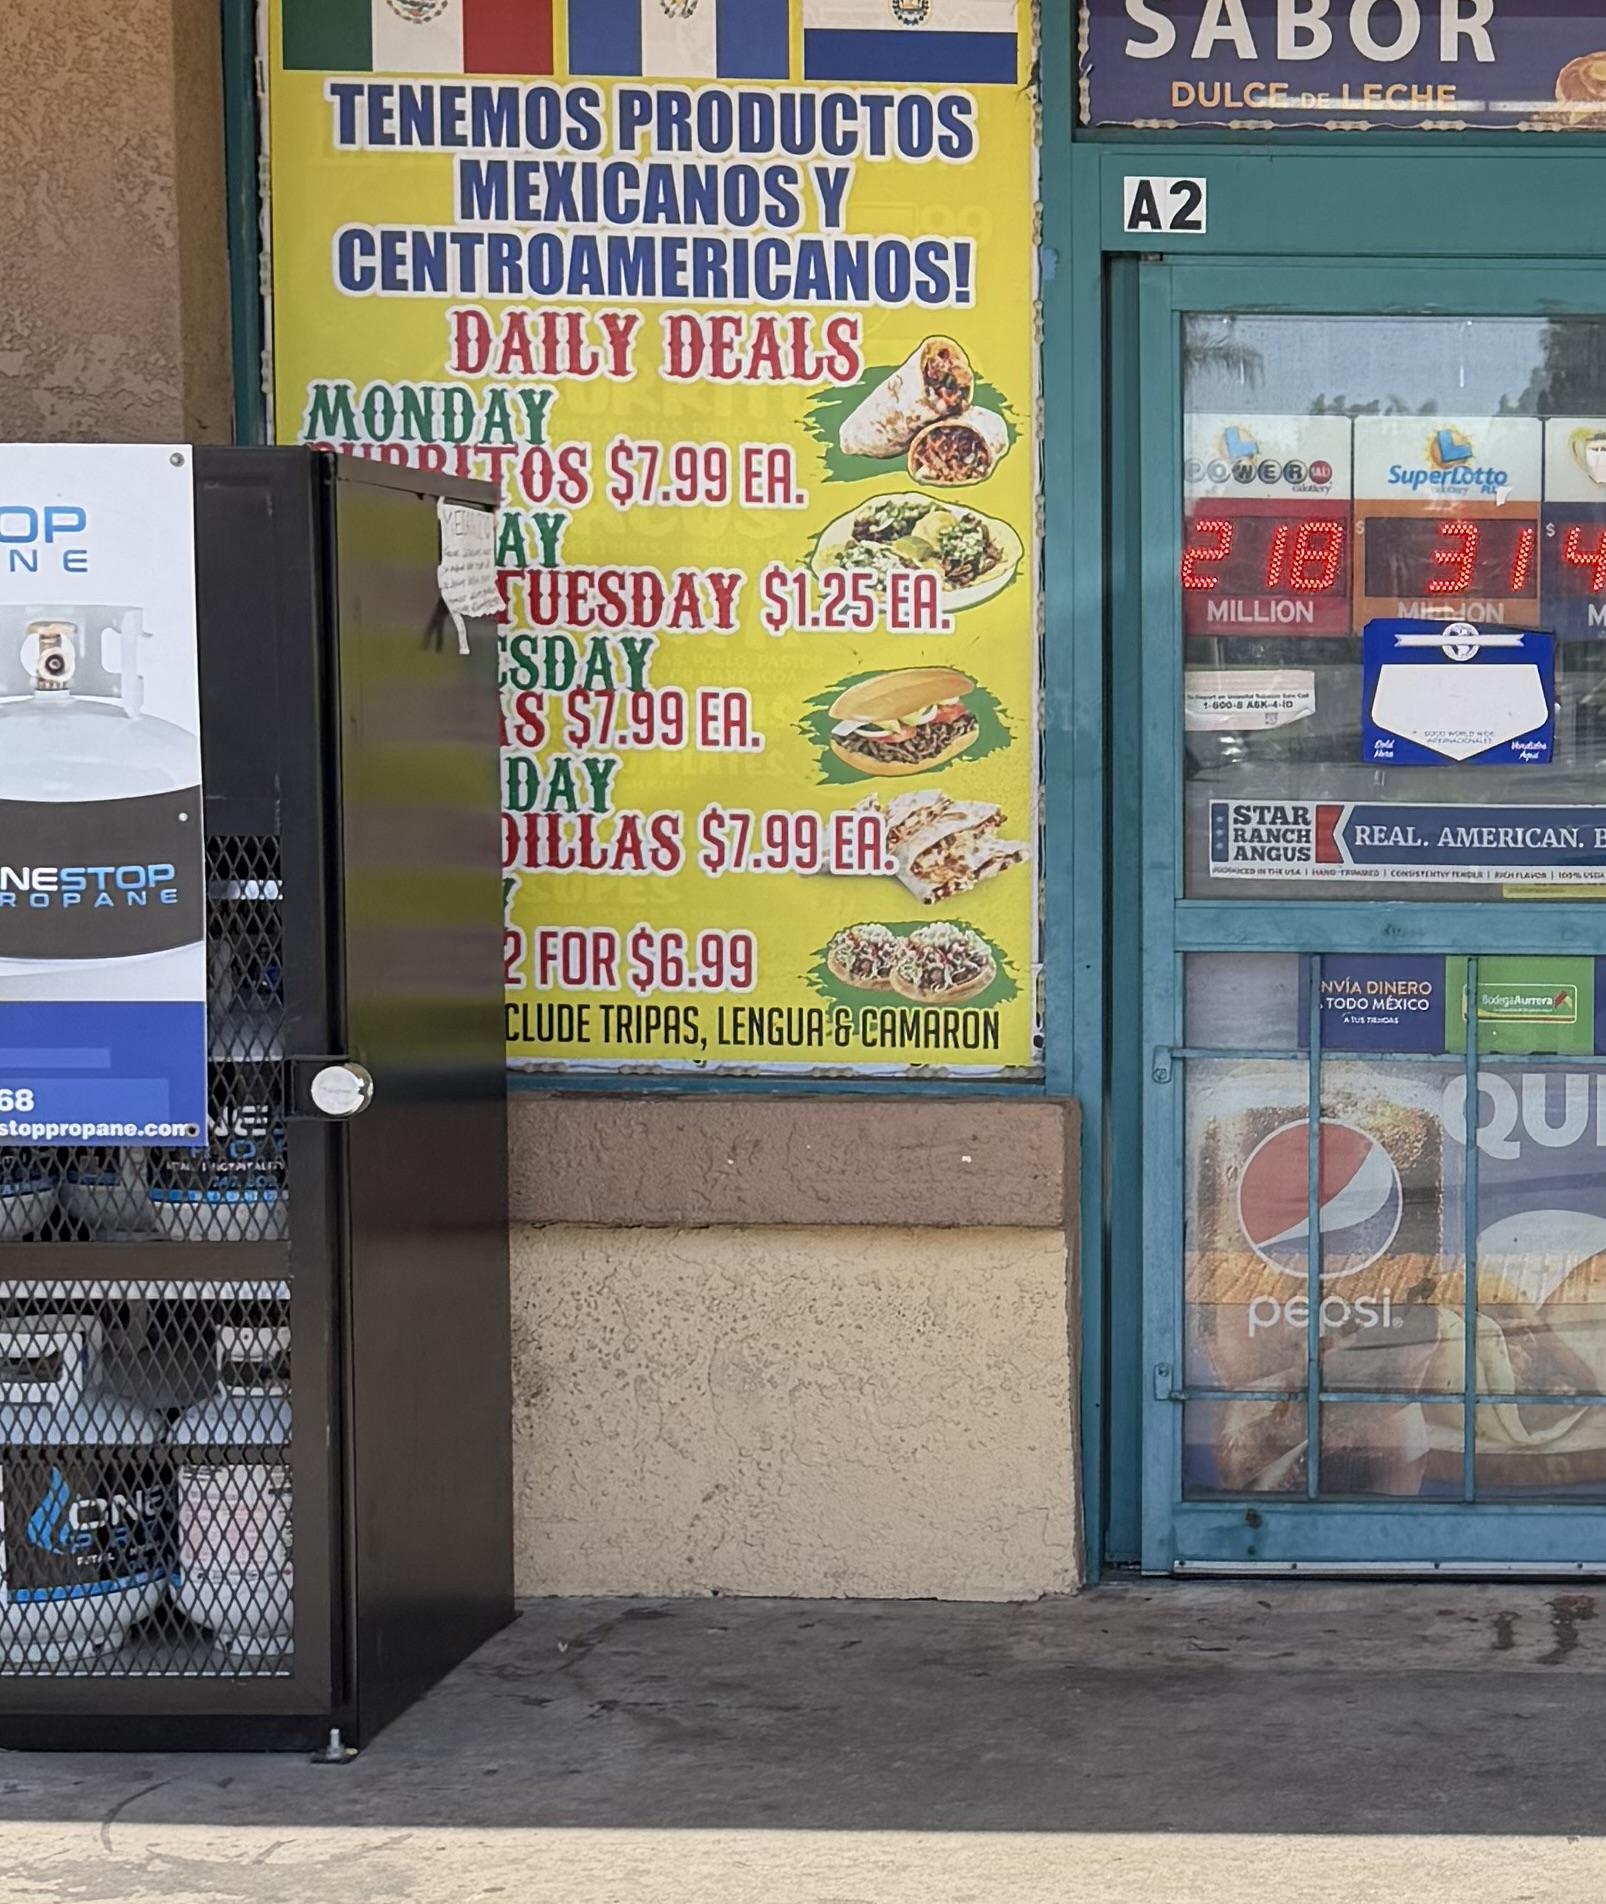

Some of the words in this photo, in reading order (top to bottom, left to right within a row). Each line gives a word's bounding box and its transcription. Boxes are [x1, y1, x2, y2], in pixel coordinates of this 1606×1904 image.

[331, 84, 604, 149] TENEMOS
[620, 89, 973, 156] PRODUCTOS
[1171, 81, 1288, 108] DULCE
[1302, 92, 1329, 108] DE
[1342, 83, 1457, 110] LECHE
[460, 160, 800, 227] MEXICANOS
[819, 166, 850, 228] Y
[1127, 179, 1202, 230] A2
[337, 229, 974, 303] CENTROAMERICANOS!
[449, 312, 640, 378] DAILY
[661, 315, 860, 382] DEALS
[305, 384, 553, 444] MONDAY
[611, 438, 725, 507] $7.99
[745, 447, 804, 503] EA.
[1388, 465, 1508, 490] SuperLotto
[496, 569, 742, 630] TUESDAY
[765, 566, 875, 633] $1.25
[888, 573, 951, 632] EA.
[1207, 601, 1314, 623] MILLION
[568, 685, 684, 749] $7.99
[701, 692, 760, 747] EA.
[703, 808, 818, 873] $7.99
[835, 815, 895, 872] EA.
[1233, 805, 1312, 826] STAR
[1233, 828, 1311, 844] RANCH
[1355, 825, 1428, 846] REAL.
[1437, 827, 1584, 848] AMERICAN.
[1233, 846, 1311, 862] ANGUS
[541, 931, 616, 986] FOR
[632, 928, 753, 992] $6.99
[1321, 977, 1362, 994] NVÍA
[1367, 981, 1432, 996] DINERO
[1327, 997, 1369, 1010] TODO
[1372, 995, 1430, 1011] MÉXICO
[603, 1005, 707, 1051] TRIPAS,
[719, 1006, 826, 1047] LENGUA
[834, 1007, 853, 1048] &
[861, 1008, 999, 1050] CAMARON
